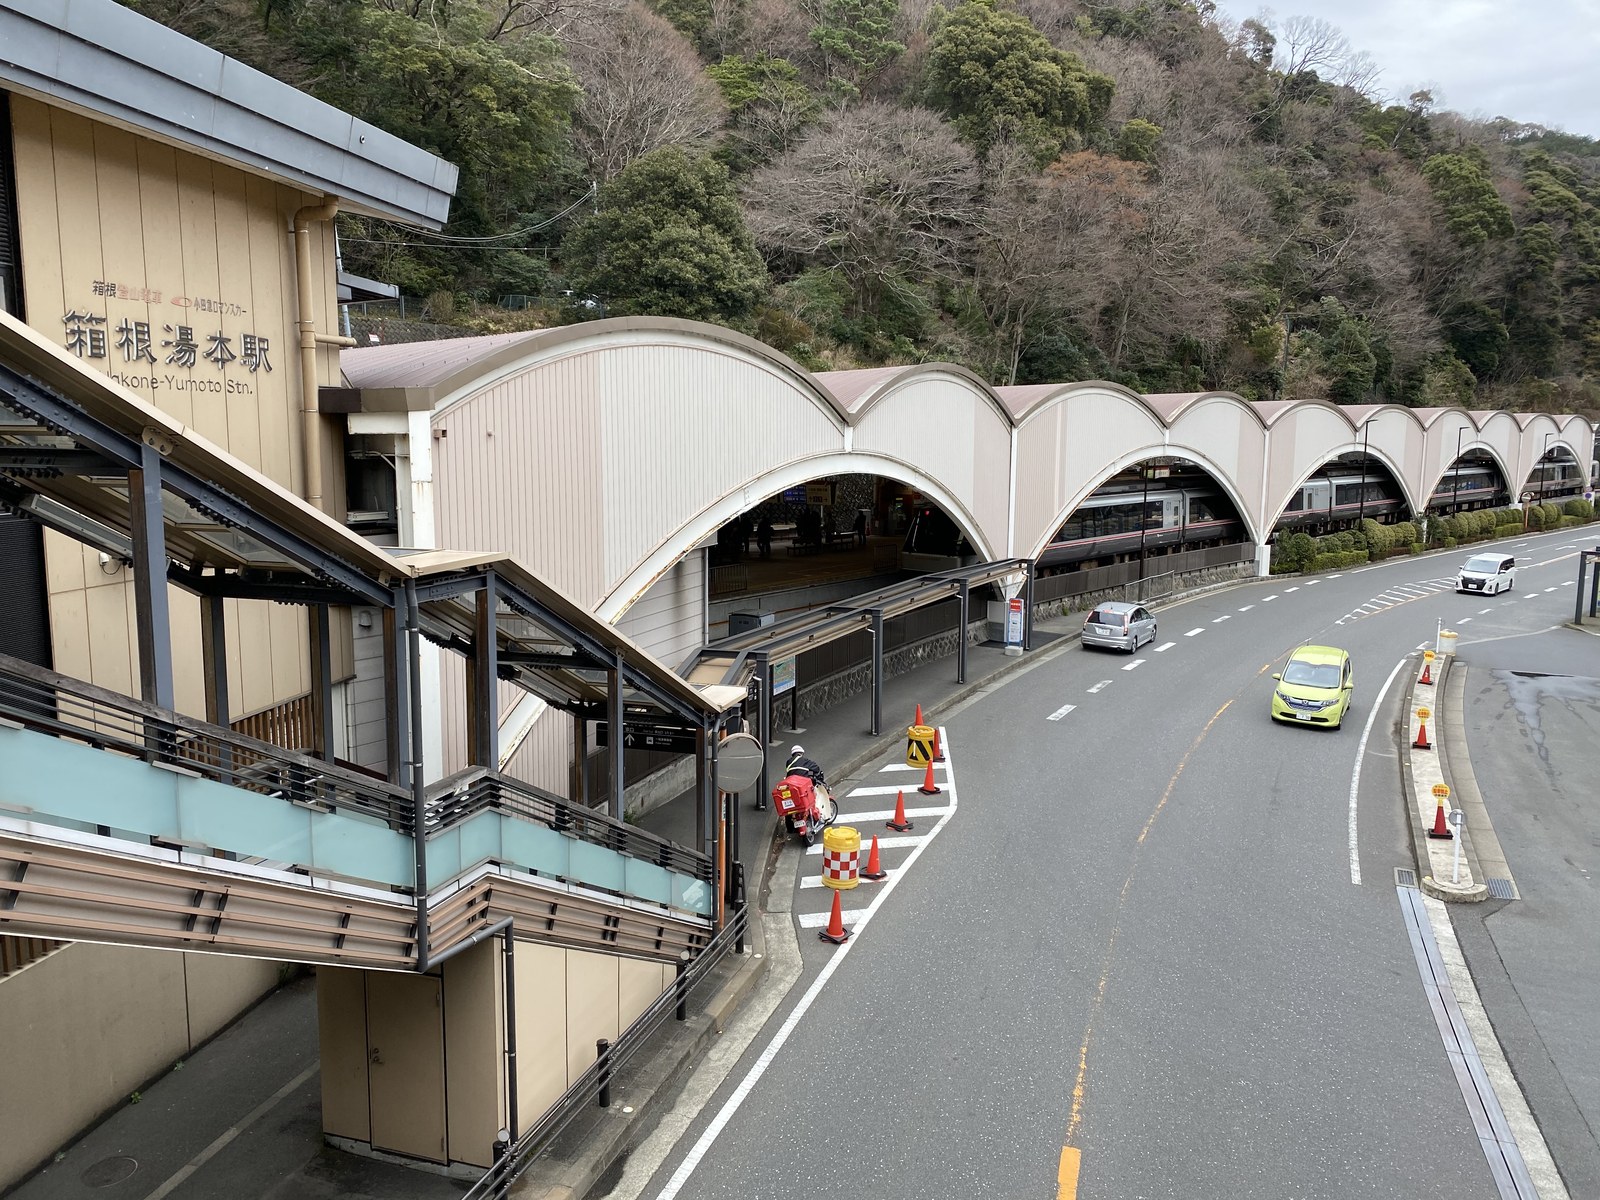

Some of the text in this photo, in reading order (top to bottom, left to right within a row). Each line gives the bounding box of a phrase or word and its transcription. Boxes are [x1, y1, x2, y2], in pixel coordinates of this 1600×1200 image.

[62, 309, 272, 373] 箱根湯本駅
[105, 370, 253, 395] akone-Yumoto Stn.
